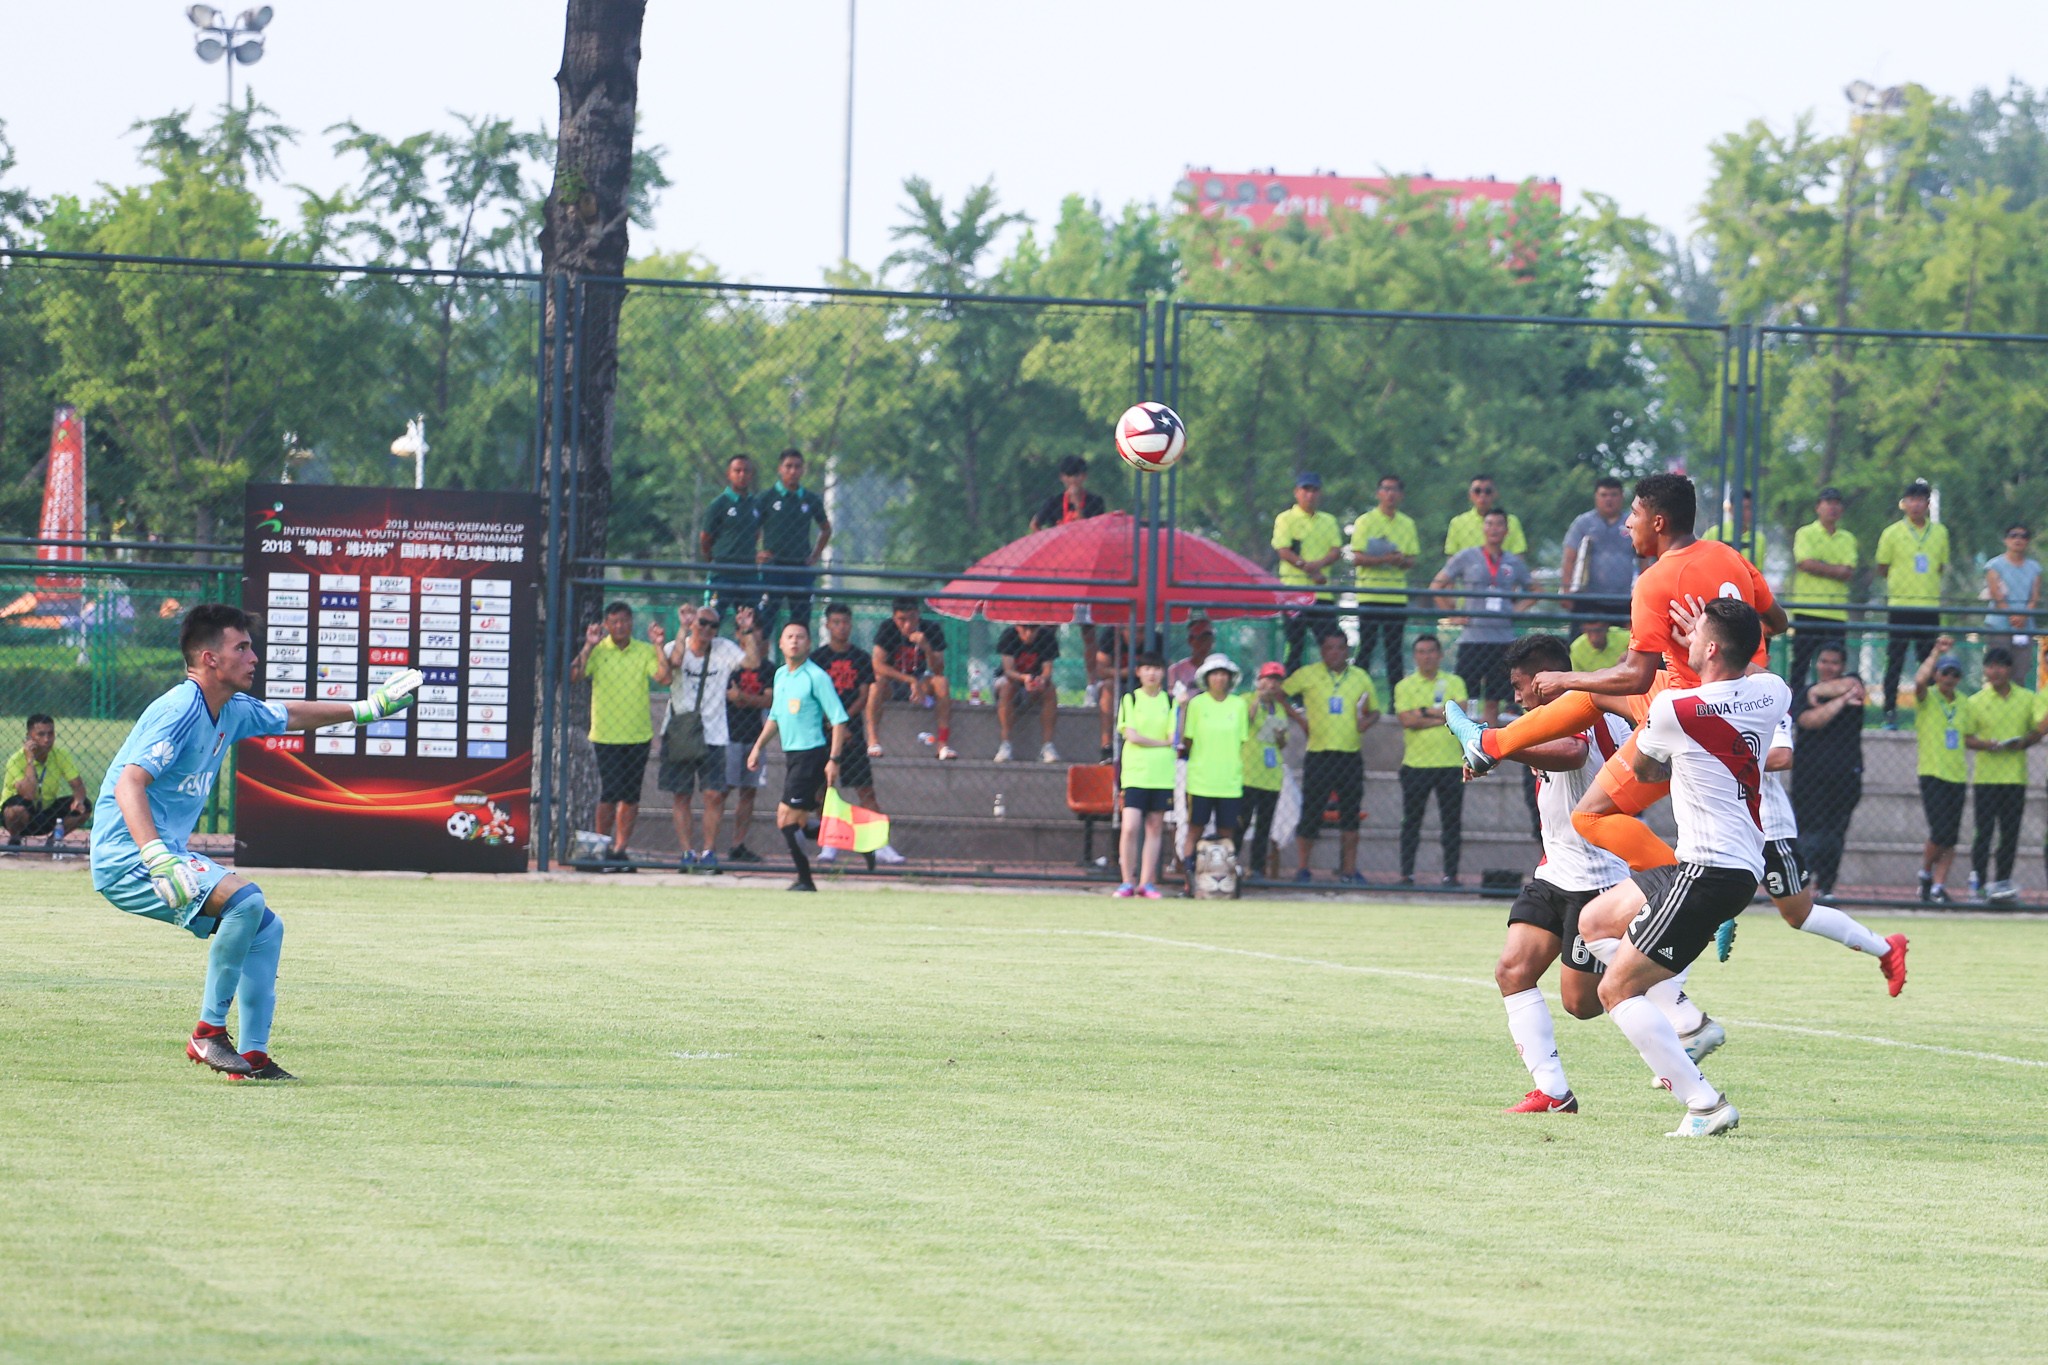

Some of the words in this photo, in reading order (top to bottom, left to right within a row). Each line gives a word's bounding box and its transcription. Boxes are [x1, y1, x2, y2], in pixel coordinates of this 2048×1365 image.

[283, 526, 363, 539] INTERNATIONAL
[365, 529, 400, 540] YOUTH
[402, 531, 452, 542] FOOTBALL
[454, 532, 525, 544] TOURNAMENT
[385, 519, 409, 530] 2018
[503, 523, 525, 534] CUP
[1695, 703, 1732, 717] BBVA
[1733, 694, 1775, 714] Francés
[1766, 870, 1785, 895] 3
[1628, 903, 1652, 936] 2
[1571, 934, 1591, 965] 6
